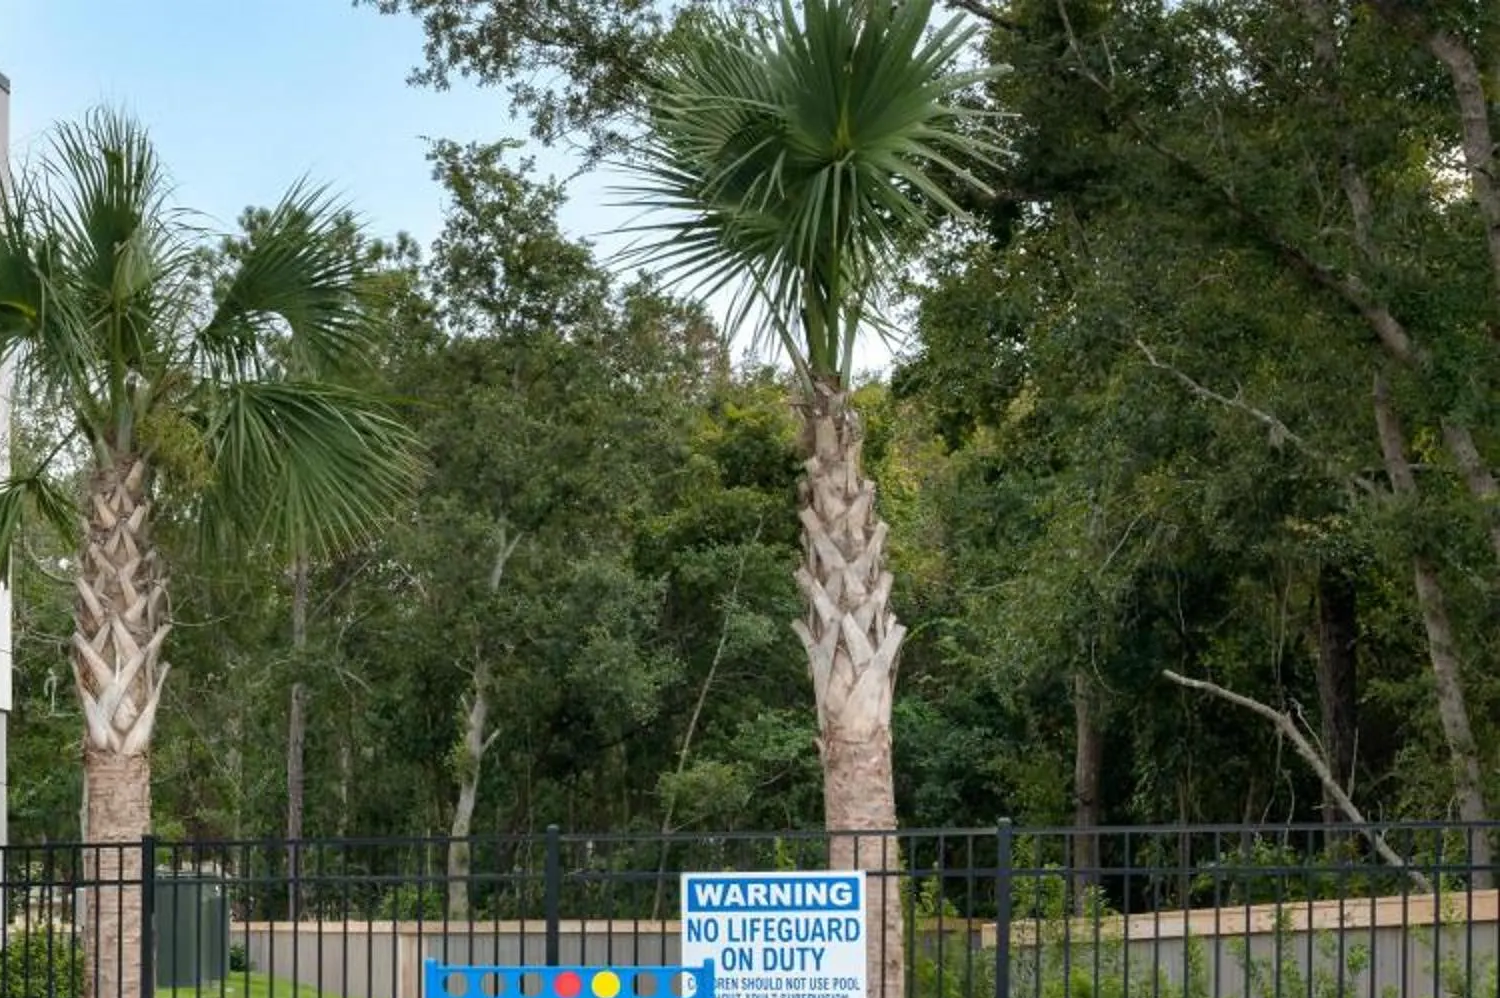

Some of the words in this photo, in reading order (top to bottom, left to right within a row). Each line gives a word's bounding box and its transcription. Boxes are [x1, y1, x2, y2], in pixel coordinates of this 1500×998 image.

[693, 882, 853, 907] WARNING
[687, 917, 719, 943] NO
[727, 917, 861, 943] LIFEGUARD
[721, 947, 753, 972] ON
[763, 947, 825, 972] DUTY
[741, 977, 783, 991] SHOULD
[785, 977, 807, 991] NOT
[809, 977, 830, 991] USE
[833, 977, 861, 991] POOL
